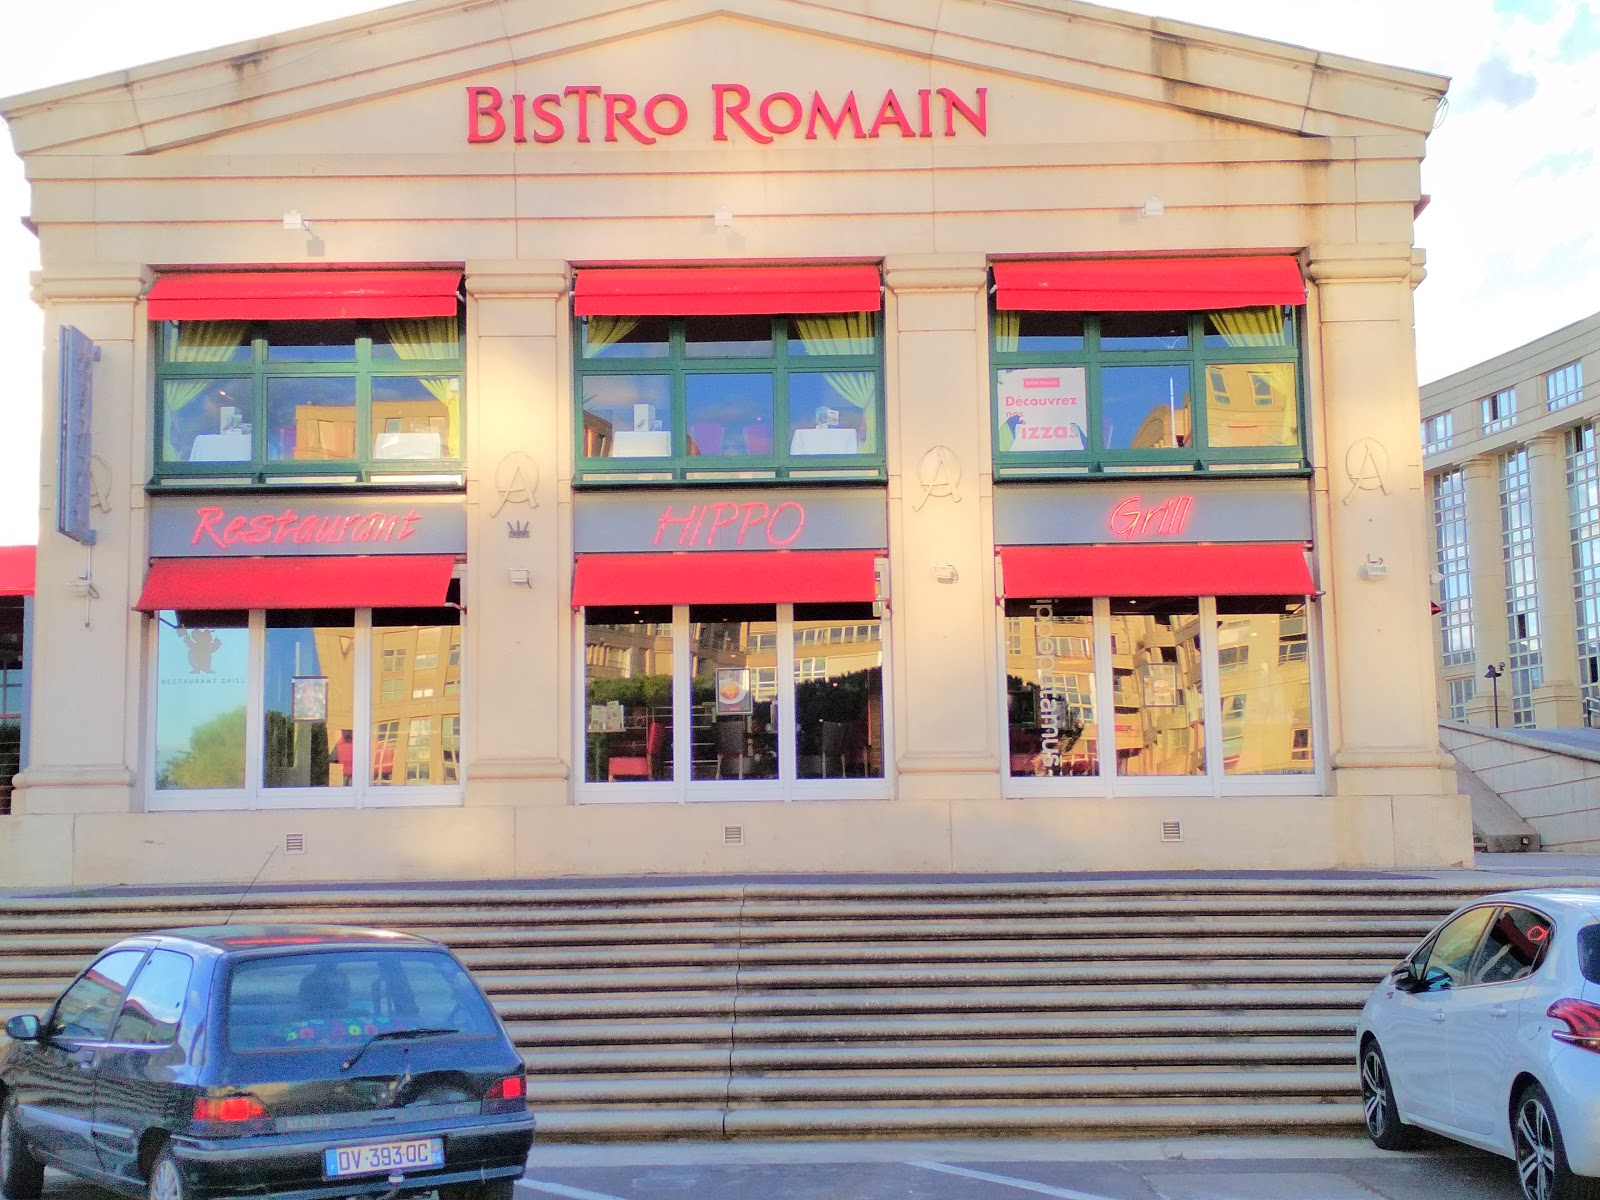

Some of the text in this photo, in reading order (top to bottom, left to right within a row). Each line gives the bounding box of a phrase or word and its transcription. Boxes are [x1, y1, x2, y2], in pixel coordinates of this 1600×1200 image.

[466, 84, 988, 145] BISTRO ROMAIN
[1020, 420, 1079, 440] izzas
[191, 506, 422, 549] Restaurant
[652, 501, 805, 546] HIPPO
[1109, 496, 1194, 540] Grill
[1029, 599, 1062, 768] ippopotamus
